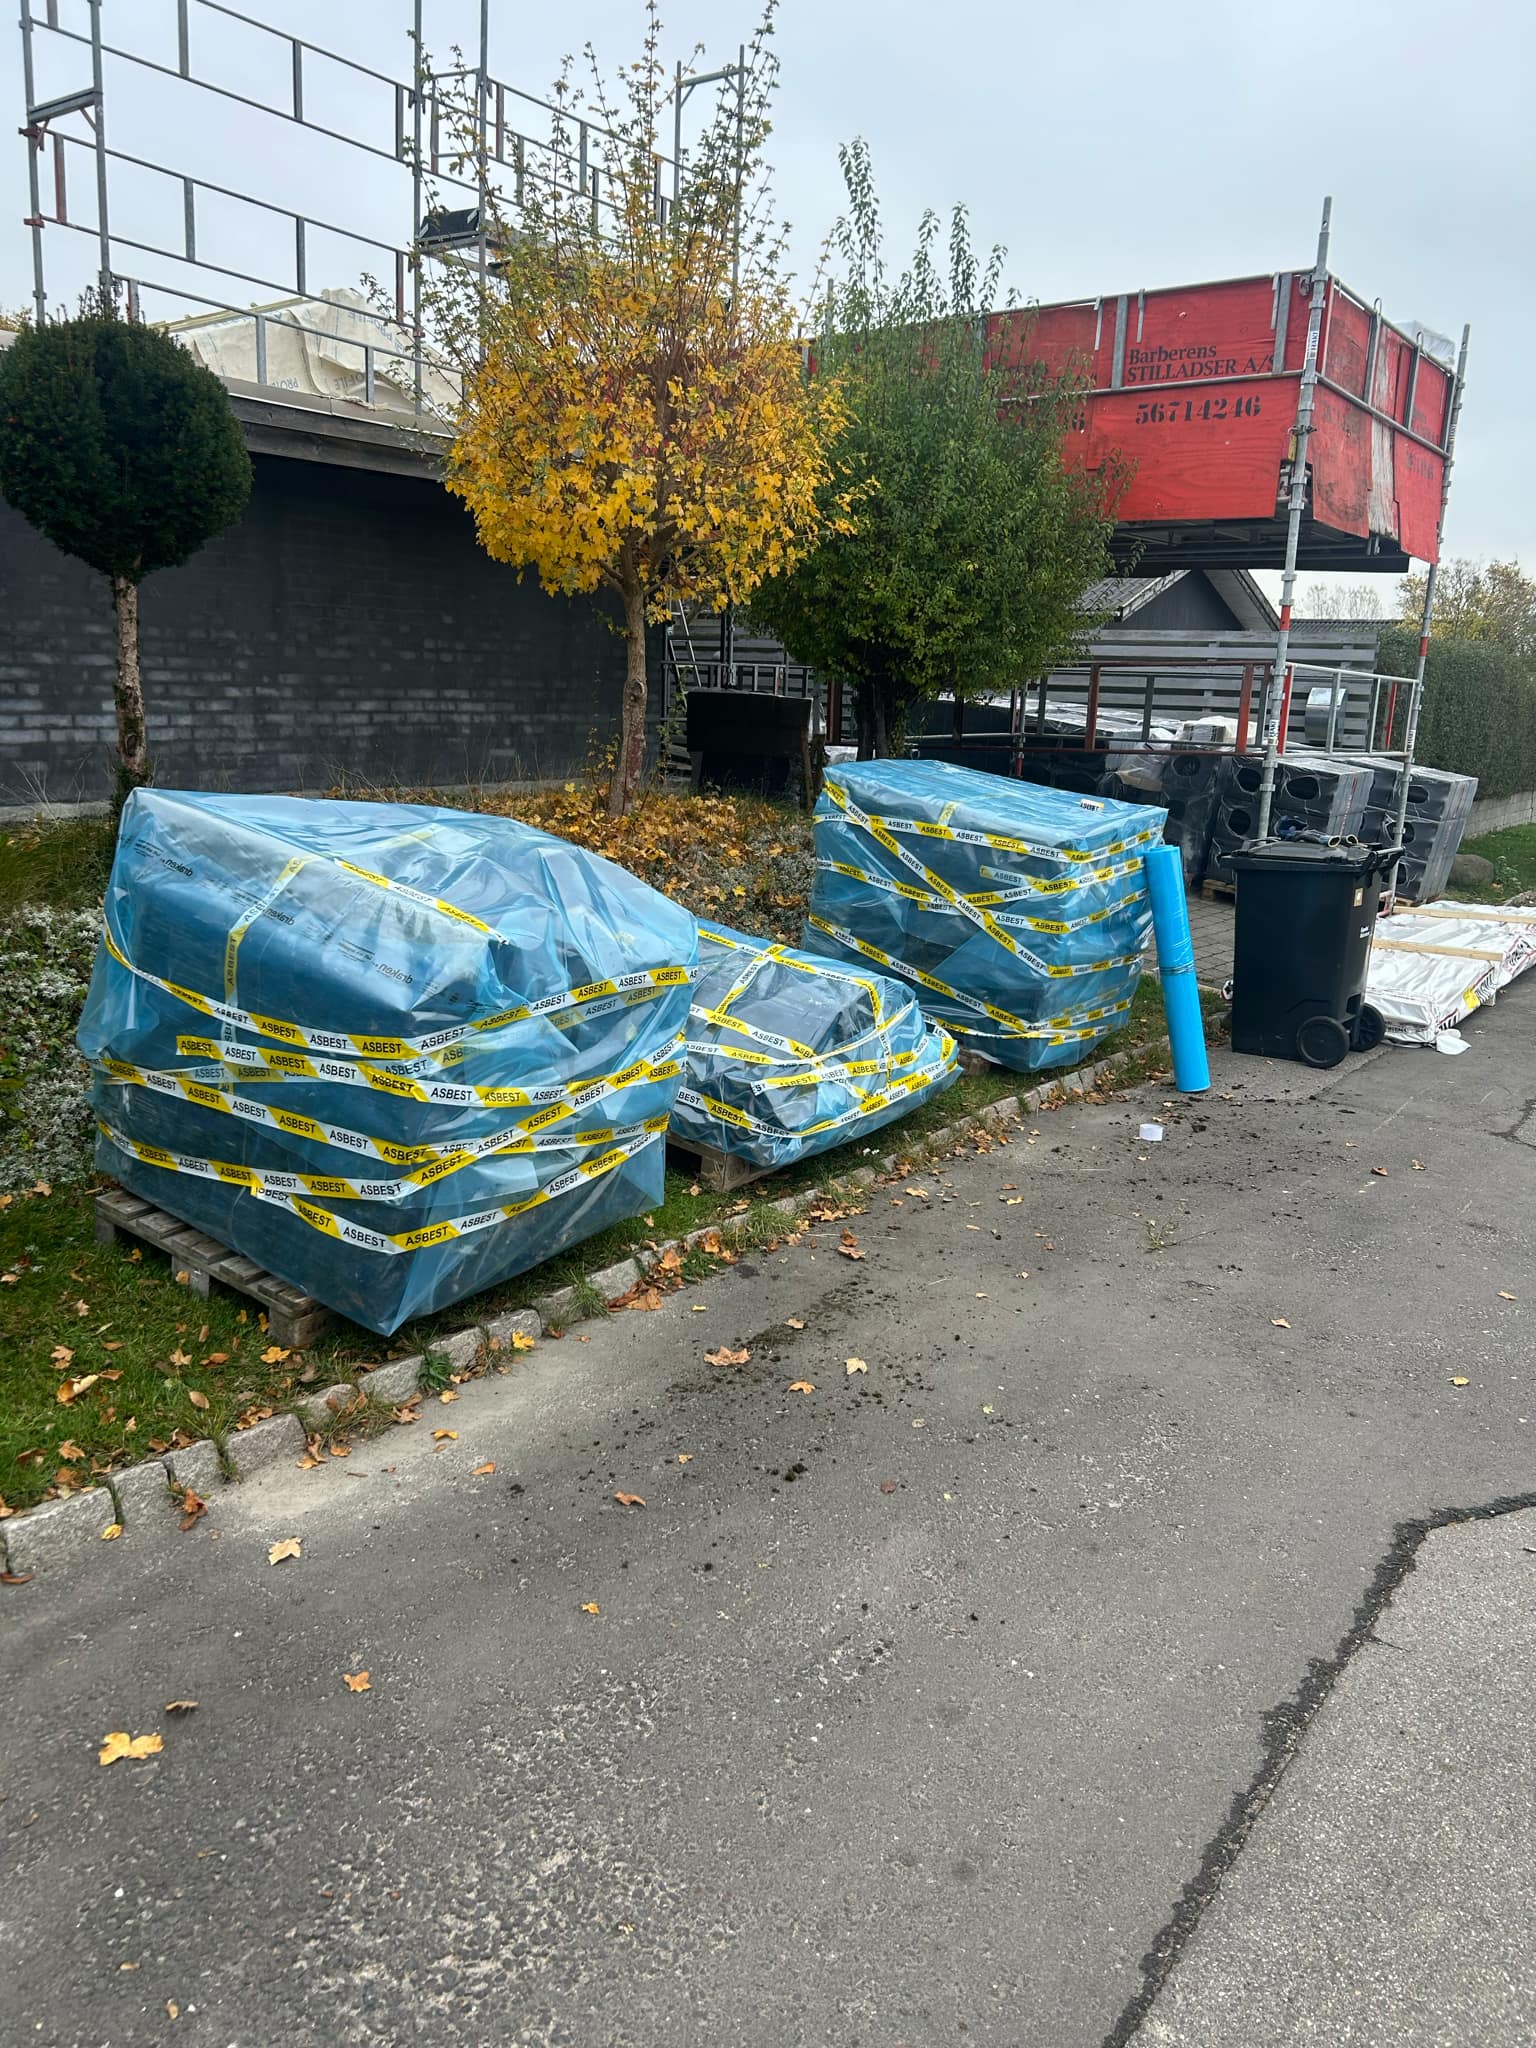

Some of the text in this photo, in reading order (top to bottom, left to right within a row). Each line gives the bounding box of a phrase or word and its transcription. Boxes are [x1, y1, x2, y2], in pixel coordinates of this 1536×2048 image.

[1129, 346, 1217, 365] Barberens
[1127, 359, 1237, 383] STILLADSER
[1136, 396, 1262, 424] 56714246
[888, 821, 913, 830] ASBEST
[921, 826, 948, 836] ASBEST
[956, 832, 983, 842] ASBEST
[1030, 846, 1059, 858] ASBEST
[848, 805, 869, 824] ASBEST
[874, 829, 895, 848] ASBEST
[901, 852, 922, 871] ASBEST
[929, 876, 951, 895] ASBEST
[957, 900, 981, 920] ASBEST
[987, 924, 1012, 946] ASBEST
[1018, 949, 1045, 969] ASBEST
[868, 875, 891, 887] ASBEST
[900, 887, 926, 899] ASBEST
[994, 872, 1022, 883] ASBEST
[1004, 888, 1032, 899] ASBEST
[1043, 881, 1073, 892] ASBEST
[996, 915, 1024, 925] ASBEST
[1035, 921, 1064, 932] ASBEST
[861, 945, 885, 960] ASBEST
[891, 961, 915, 975] ASBEST
[922, 977, 948, 992] ASBEST
[956, 993, 982, 1008] ASBEST
[990, 1009, 1018, 1024] ASBEST
[261, 1022, 296, 1038] ASBEST
[310, 1034, 347, 1049] ASBEST
[362, 1042, 401, 1054] ASBEST
[421, 1027, 466, 1050] ASBEST
[533, 994, 567, 1011] ASBEST
[578, 982, 609, 998] ASBEST
[619, 975, 647, 987] ASBEST
[656, 971, 682, 981] ASBEST
[586, 1000, 617, 1016] ASBEST
[711, 1014, 742, 1029] ASBEST
[752, 1031, 783, 1046] ASBEST
[386, 1060, 428, 1076] ASBEST
[731, 1052, 766, 1062] ASBEST
[181, 1040, 212, 1052] ASBEST
[225, 1047, 256, 1061] ASBEST
[270, 1055, 305, 1069] ASBEST
[320, 1064, 356, 1080] ASBEST
[431, 1087, 472, 1101] ASBEST
[485, 1092, 520, 1102] ASBEST
[533, 1089, 563, 1101] ASBEST
[195, 1066, 225, 1078] ASBEST
[649, 1065, 674, 1077] ASBEST
[679, 1092, 700, 1104] BEST
[109, 1063, 136, 1078] ASBEST
[147, 1073, 176, 1090] ASBEST
[188, 1087, 220, 1104] ASBEST
[232, 1101, 266, 1118] ASBEST
[279, 1115, 315, 1133] ASBEST
[329, 1130, 368, 1149] ASBEST
[383, 1146, 427, 1161] ASBEST
[139, 1147, 168, 1161] ASBEST
[179, 1158, 208, 1172] ASBEST
[220, 1167, 251, 1180] ASBEST
[264, 1175, 297, 1188] ASBEST
[311, 1181, 346, 1193] ASBEST
[360, 1183, 402, 1195] ASBEST
[421, 1154, 463, 1182] ASBEST
[477, 1129, 515, 1154] ASBEST
[527, 1107, 562, 1130] ASBEST
[574, 1085, 605, 1107] ASBEST
[615, 1064, 644, 1085] ASBEST
[653, 1042, 675, 1064] ASBEST
[711, 1104, 743, 1122] ASBEST
[549, 1173, 578, 1194] ASBEST
[588, 1153, 618, 1174] ASBEST
[299, 1205, 332, 1228] ASBEST
[343, 1227, 386, 1248] ASBEST
[405, 1226, 448, 1246] ASBEST
[460, 1212, 497, 1230] ASBEST
